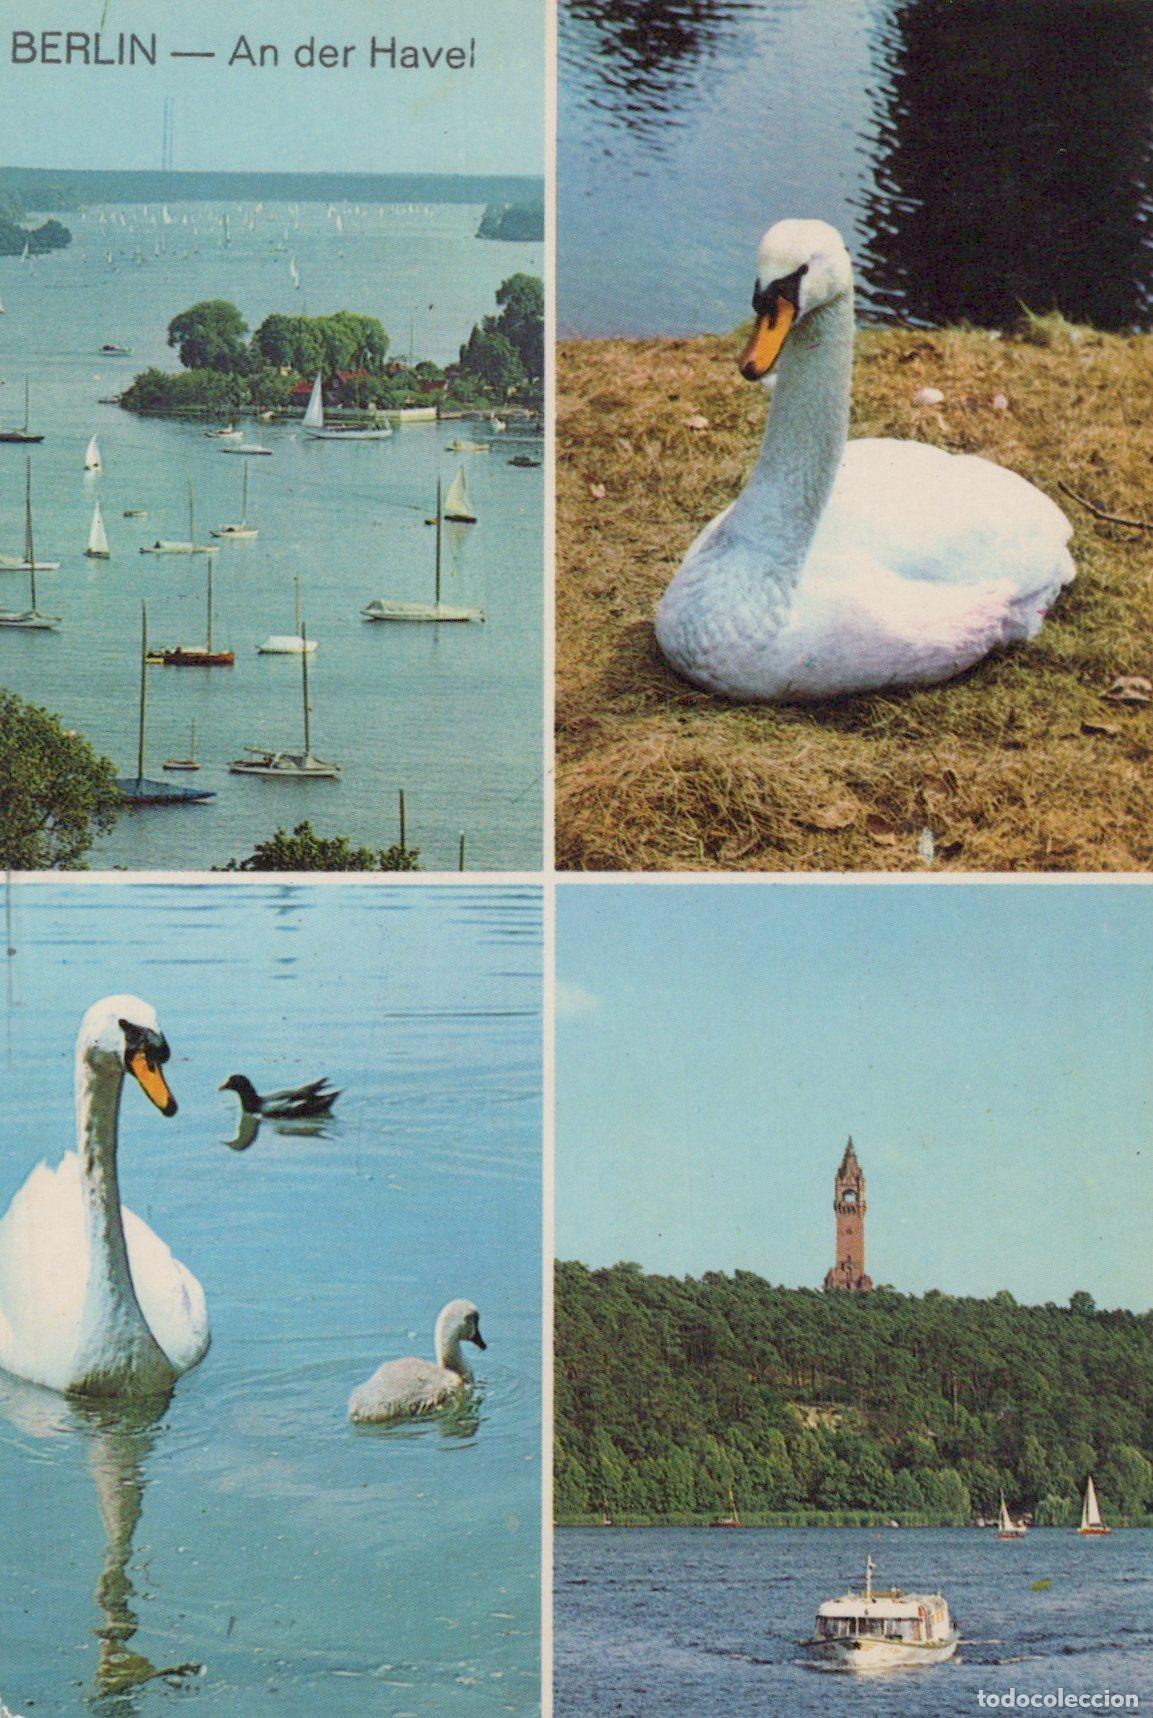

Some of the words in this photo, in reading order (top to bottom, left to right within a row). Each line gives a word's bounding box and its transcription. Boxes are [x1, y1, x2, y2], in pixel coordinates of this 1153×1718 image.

[11, 31, 157, 66] BERLIN
[228, 35, 279, 67] An
[294, 36, 356, 68] der
[370, 36, 476, 69] Havel
